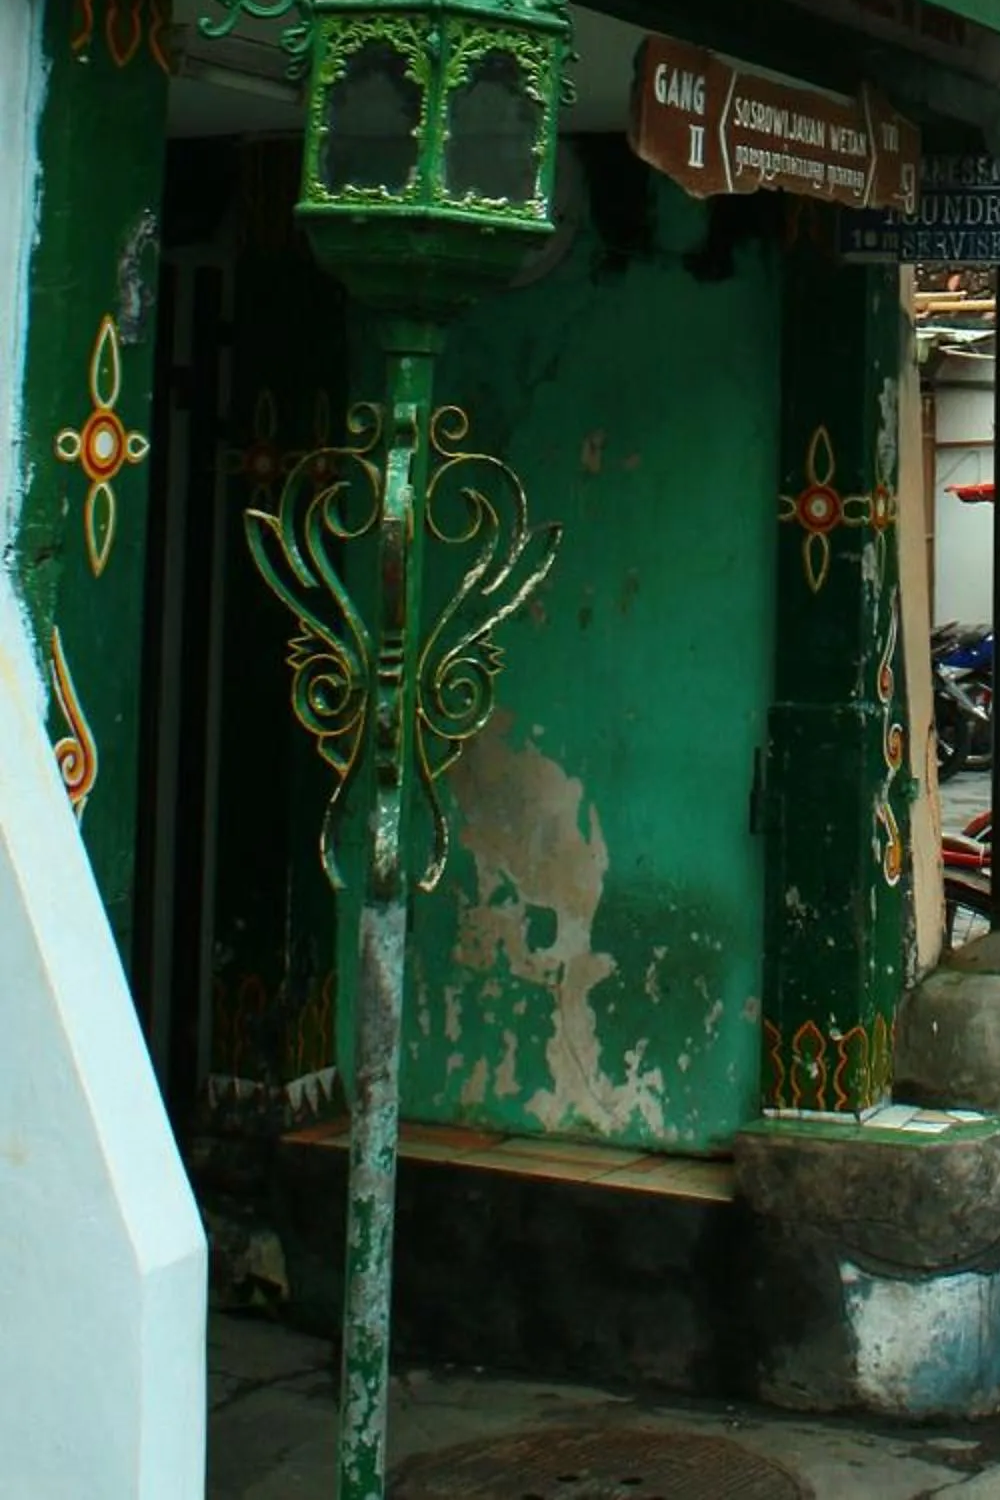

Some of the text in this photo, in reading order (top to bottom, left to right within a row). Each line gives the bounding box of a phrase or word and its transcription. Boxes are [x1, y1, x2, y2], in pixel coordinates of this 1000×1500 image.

[654, 63, 706, 116] GANG
[687, 124, 705, 168] II
[733, 96, 867, 158] SOSROWIJAYAN WETAN
